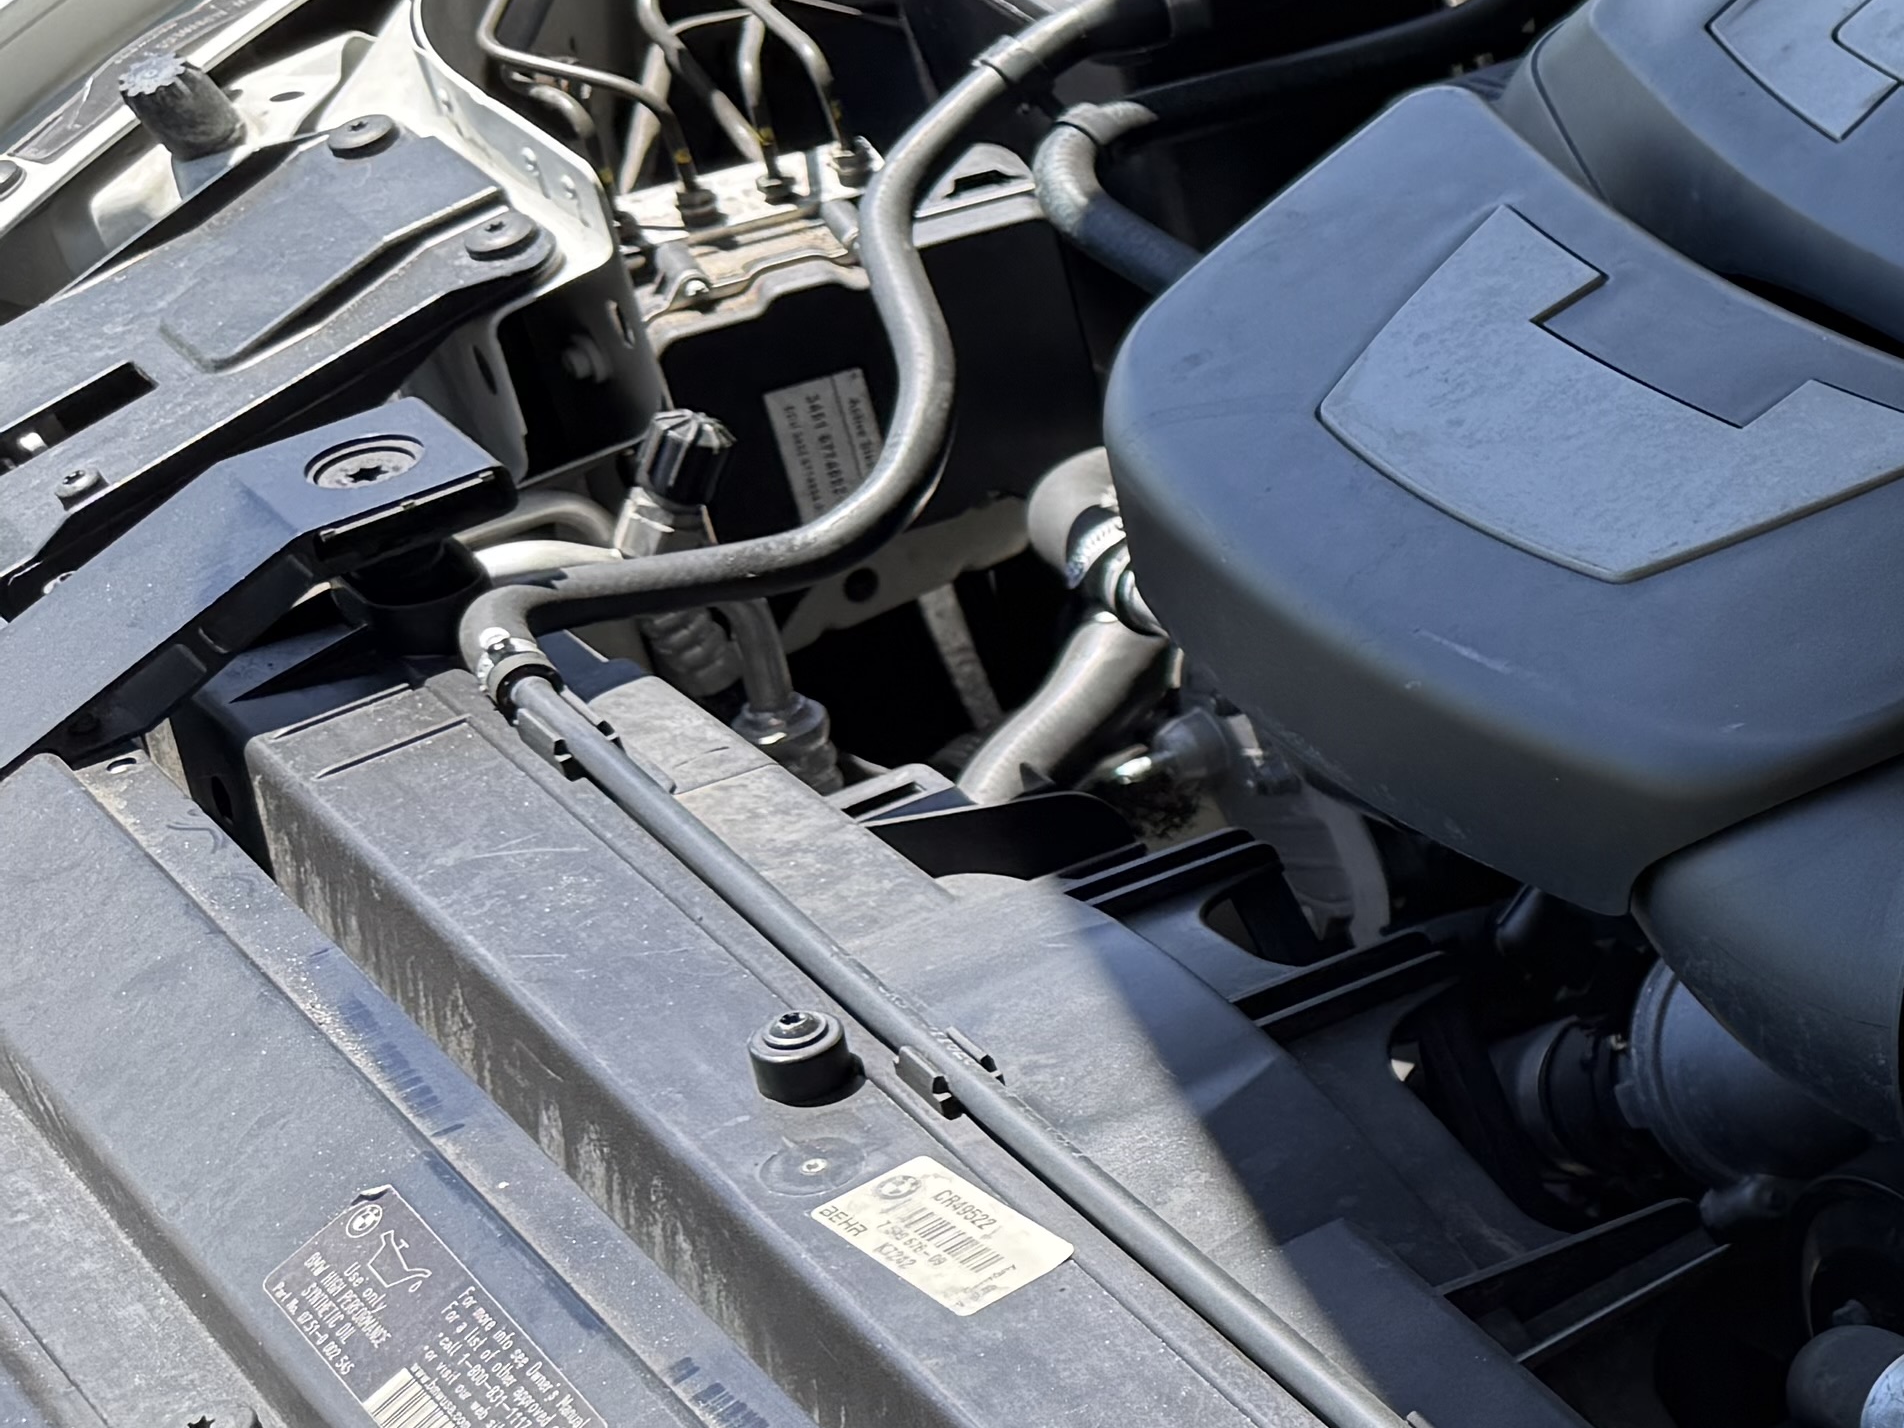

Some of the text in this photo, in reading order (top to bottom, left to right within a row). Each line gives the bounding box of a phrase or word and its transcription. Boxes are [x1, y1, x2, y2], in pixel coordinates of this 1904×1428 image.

[819, 1205, 868, 1236] BEHR
[932, 1189, 997, 1230] CR49522
[272, 1281, 292, 1302] Part
[301, 1282, 356, 1345] SYNTHETIC OIL
[304, 1252, 391, 1348] BMW HIGH PERFORMANCE
[343, 1261, 387, 1313] Use only
[439, 1337, 463, 1357] call
[441, 1300, 460, 1323] For
[455, 1322, 468, 1334] a
[463, 1326, 488, 1351] list
[480, 1349, 501, 1363] of
[491, 1362, 517, 1387] other
[513, 1386, 556, 1427] approved
[458, 1286, 477, 1309] For
[472, 1307, 496, 1331] more
[492, 1330, 515, 1350] info
[510, 1348, 529, 1368] see
[526, 1361, 559, 1402] Owner's
[436, 1362, 461, 1385] visit
[454, 1384, 472, 1400] our
[470, 1401, 491, 1420] web
